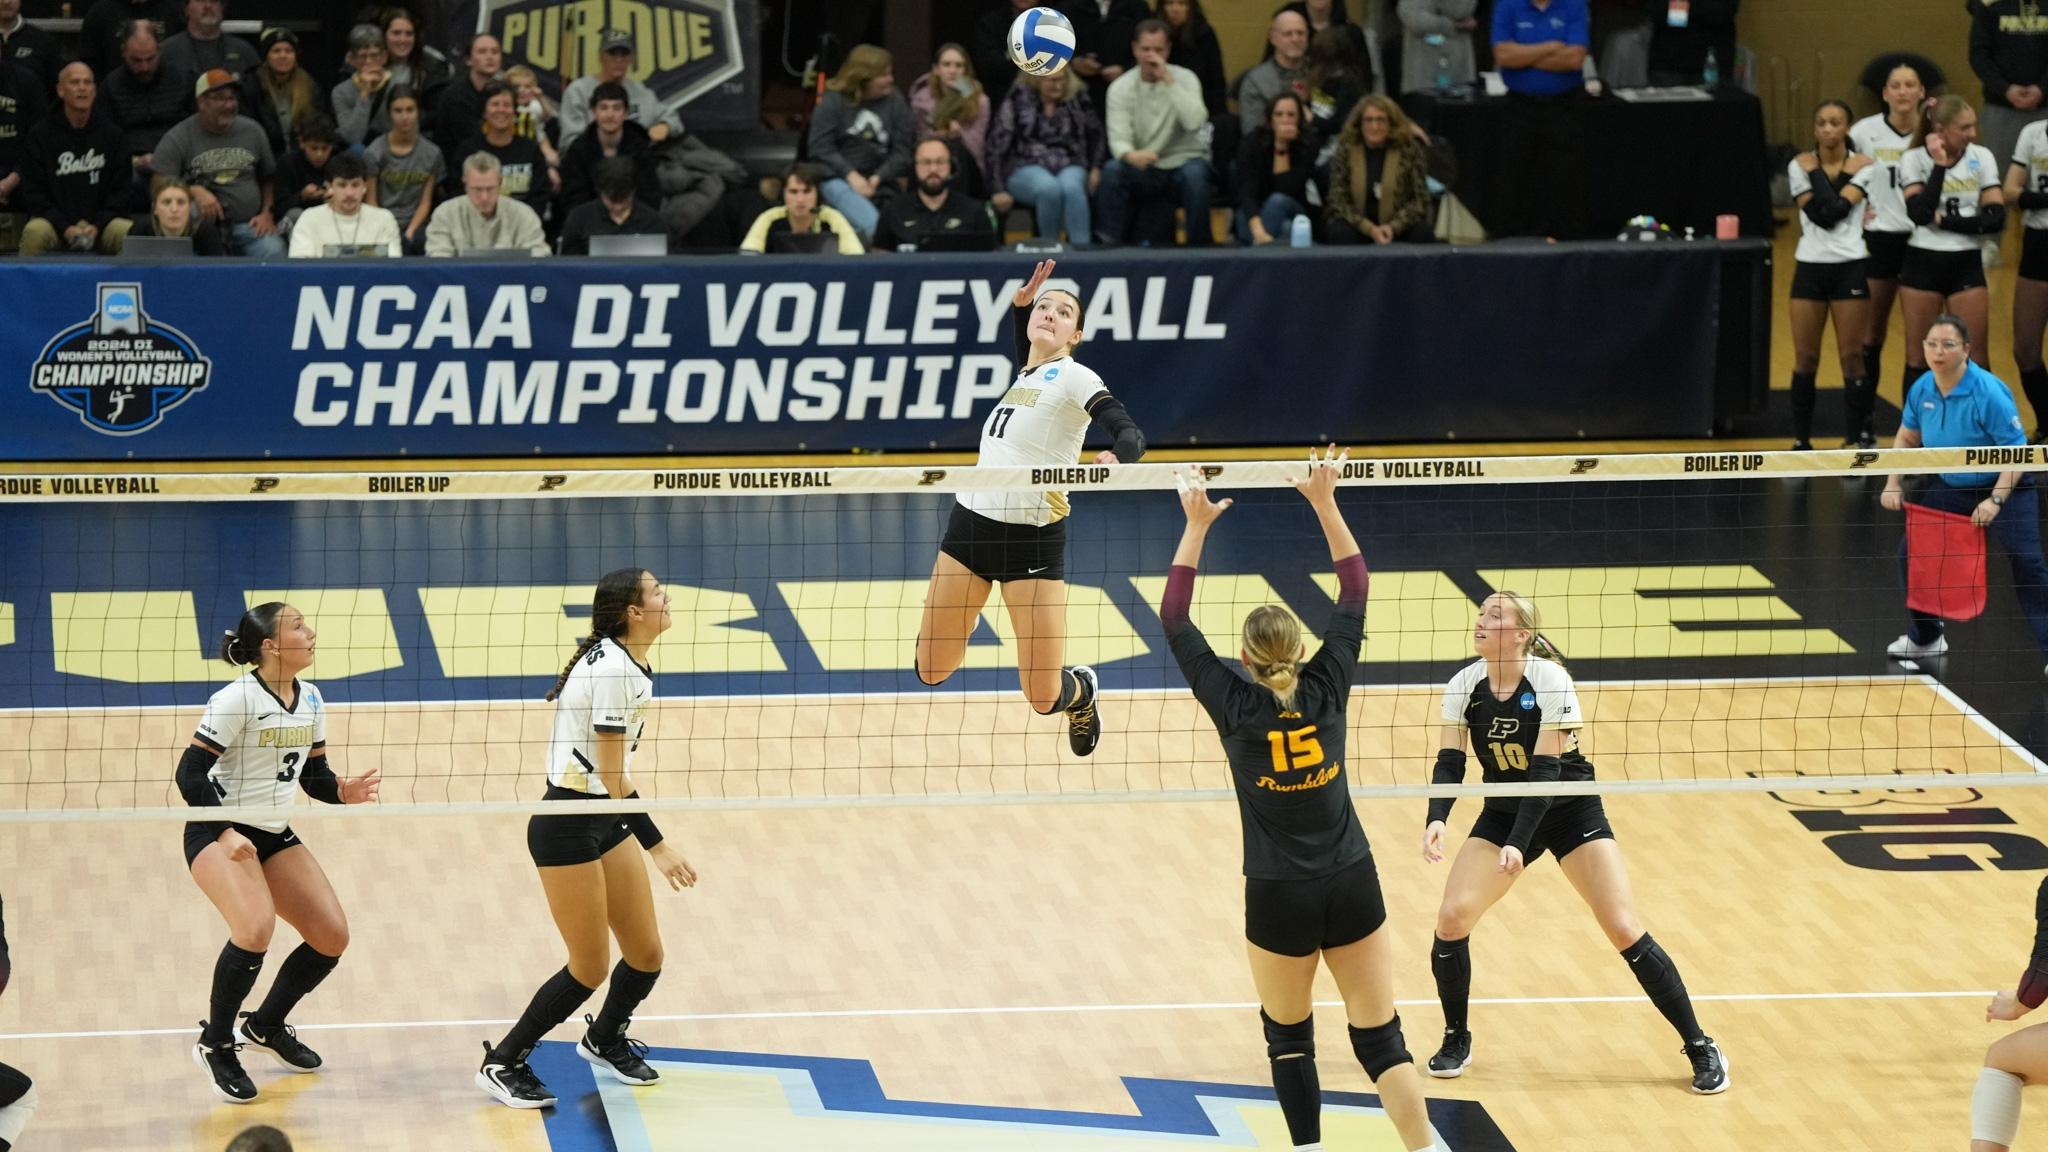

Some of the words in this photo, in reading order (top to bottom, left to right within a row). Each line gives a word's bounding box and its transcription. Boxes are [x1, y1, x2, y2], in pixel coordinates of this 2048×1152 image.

[502, 0, 714, 82] PURDUE
[107, 304, 134, 313] NCAA
[292, 285, 532, 350] NCAA
[571, 284, 680, 348] DI
[706, 276, 1228, 347] VOLLEYALL
[87, 339, 131, 351] 2024
[133, 339, 154, 350] DI
[57, 350, 113, 362] WOMEN'S
[115, 350, 185, 361] VOLLEYBALL
[37, 363, 204, 386] CHAMPIONSHIP
[293, 354, 1012, 427] CHAMPIONSHIP
[989, 407, 1015, 439] 17
[1684, 455, 1739, 473] BOILER
[1742, 454, 1764, 471] UP
[1965, 447, 2034, 466] PURDUE
[1031, 468, 1086, 485] BOILER
[1088, 467, 1110, 484] UP
[1382, 460, 1485, 479] VOLLEYBALL
[50, 476, 160, 495] VOLLEYBALL
[368, 476, 425, 493] BOILER
[428, 476, 451, 493] UP
[653, 472, 721, 490] PURDUE
[728, 471, 832, 489] VOLLEYBALL
[0, 563, 1856, 686] URDUE
[1487, 717, 1520, 739] P
[1267, 724, 1325, 773] 15
[1487, 741, 1530, 772] 10
[277, 751, 300, 783] 3
